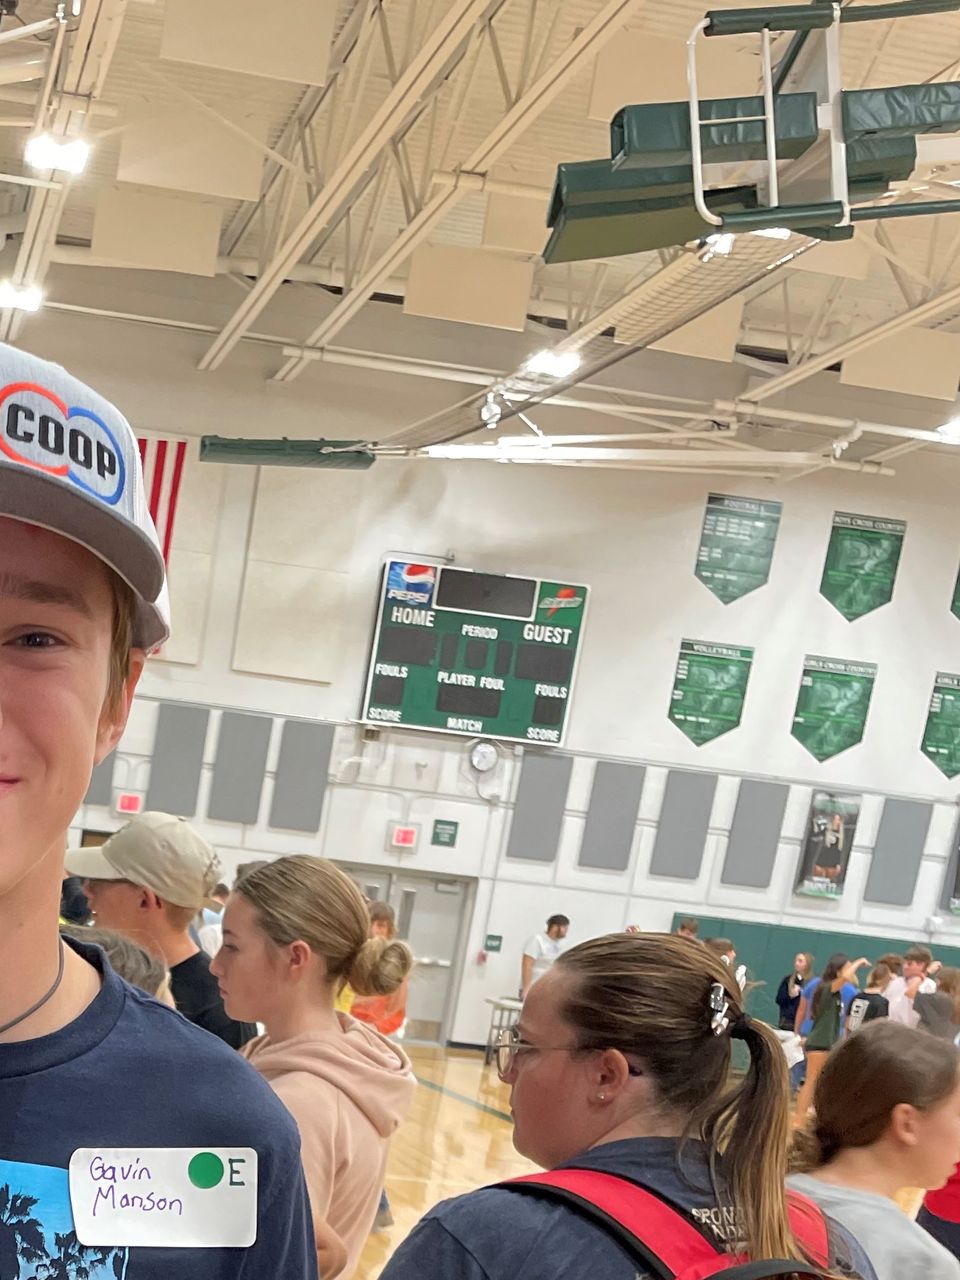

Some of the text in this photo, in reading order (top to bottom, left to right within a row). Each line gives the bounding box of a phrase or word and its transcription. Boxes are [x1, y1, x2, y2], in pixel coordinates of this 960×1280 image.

[6, 403, 116, 480] COOP
[391, 607, 436, 627] HOME
[461, 624, 498, 640] PERIOD
[522, 624, 573, 645] GUEST
[375, 663, 408, 678] FOULS
[437, 671, 505, 691] PLAYER FOUL
[535, 683, 568, 699] FOULS
[369, 707, 402, 723] SCORE
[447, 717, 483, 732] MATCH
[527, 727, 560, 742] SCORE
[90, 1156, 151, 1183] Gavin
[228, 1158, 246, 1186] E
[93, 1185, 183, 1216] Manson
